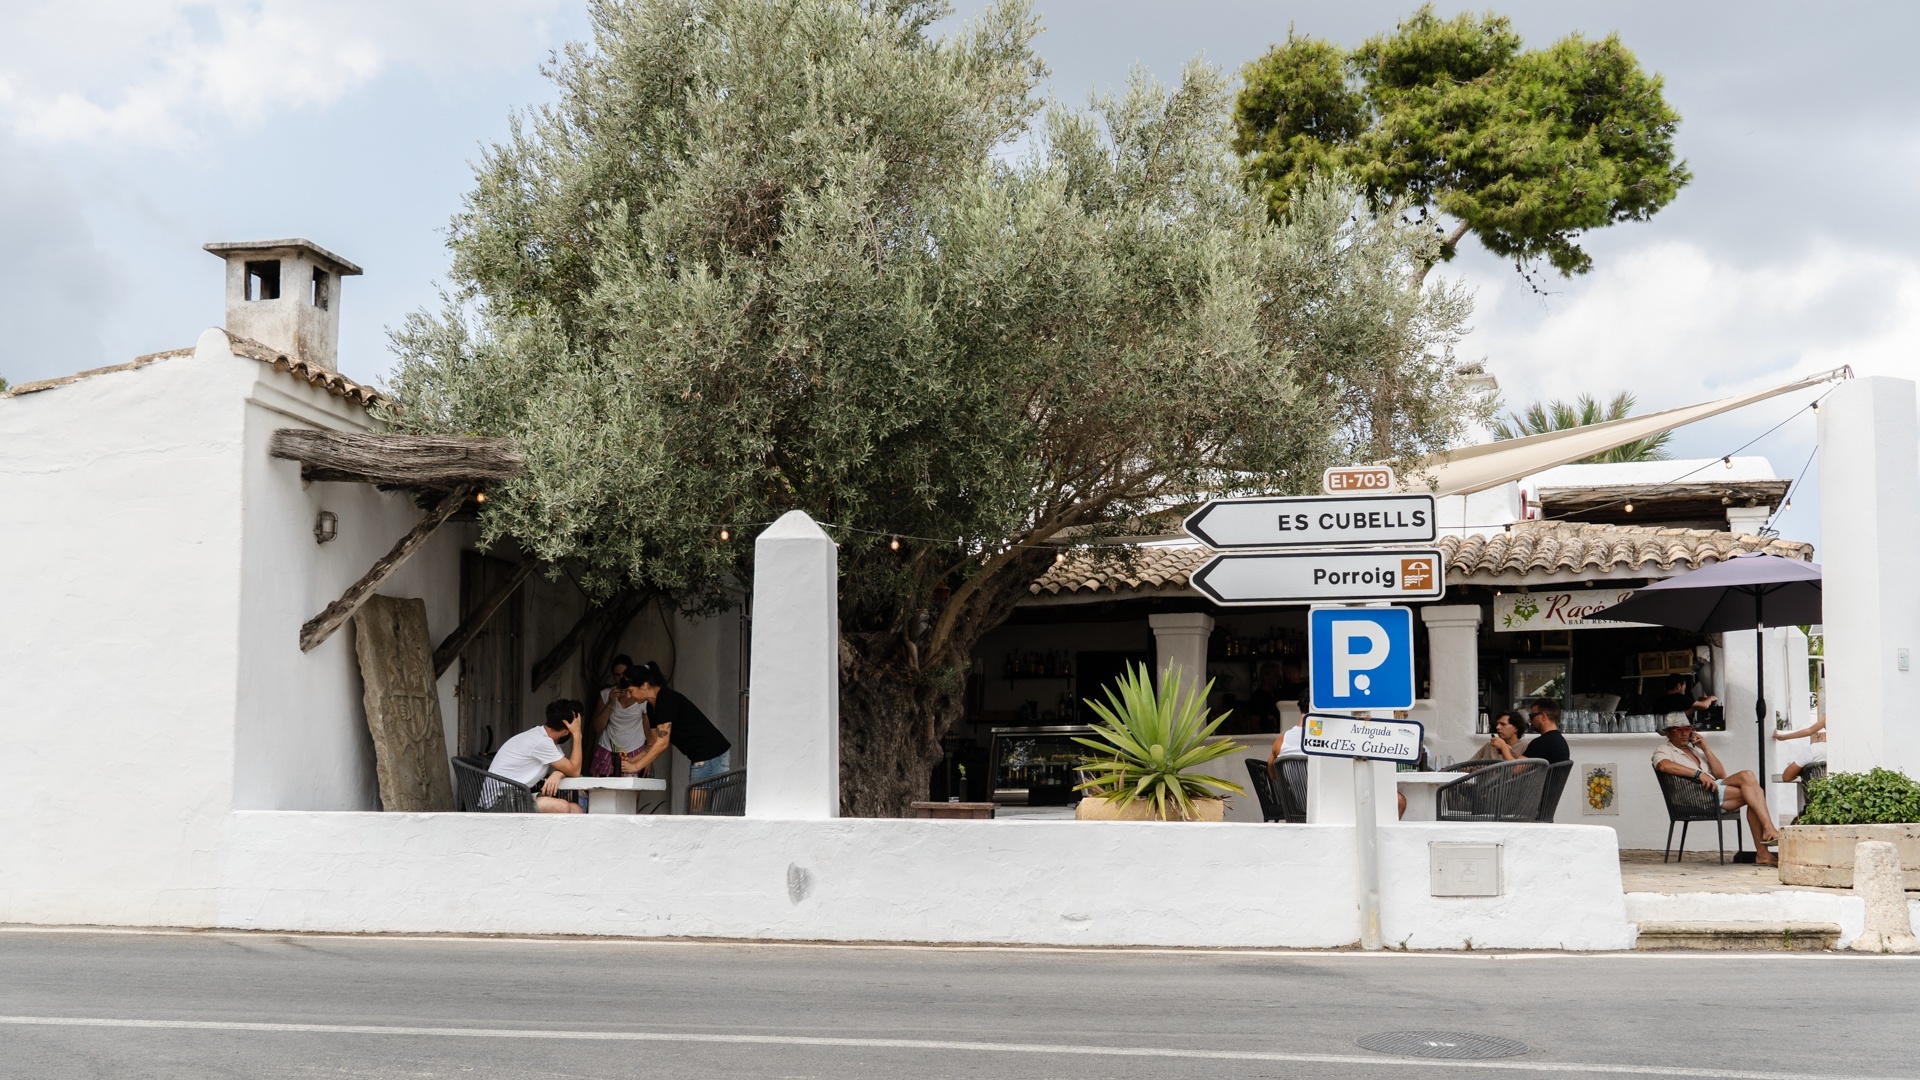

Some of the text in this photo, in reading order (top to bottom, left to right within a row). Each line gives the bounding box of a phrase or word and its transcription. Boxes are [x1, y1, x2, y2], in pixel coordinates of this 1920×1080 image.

[1330, 473, 1387, 488] EI-703
[1278, 510, 1426, 531] ES CUBELLS
[1313, 567, 1396, 588] Porroig
[1331, 620, 1390, 698] P
[1350, 723, 1392, 739] Avinguda
[1330, 739, 1410, 756] d'Es Cubells
